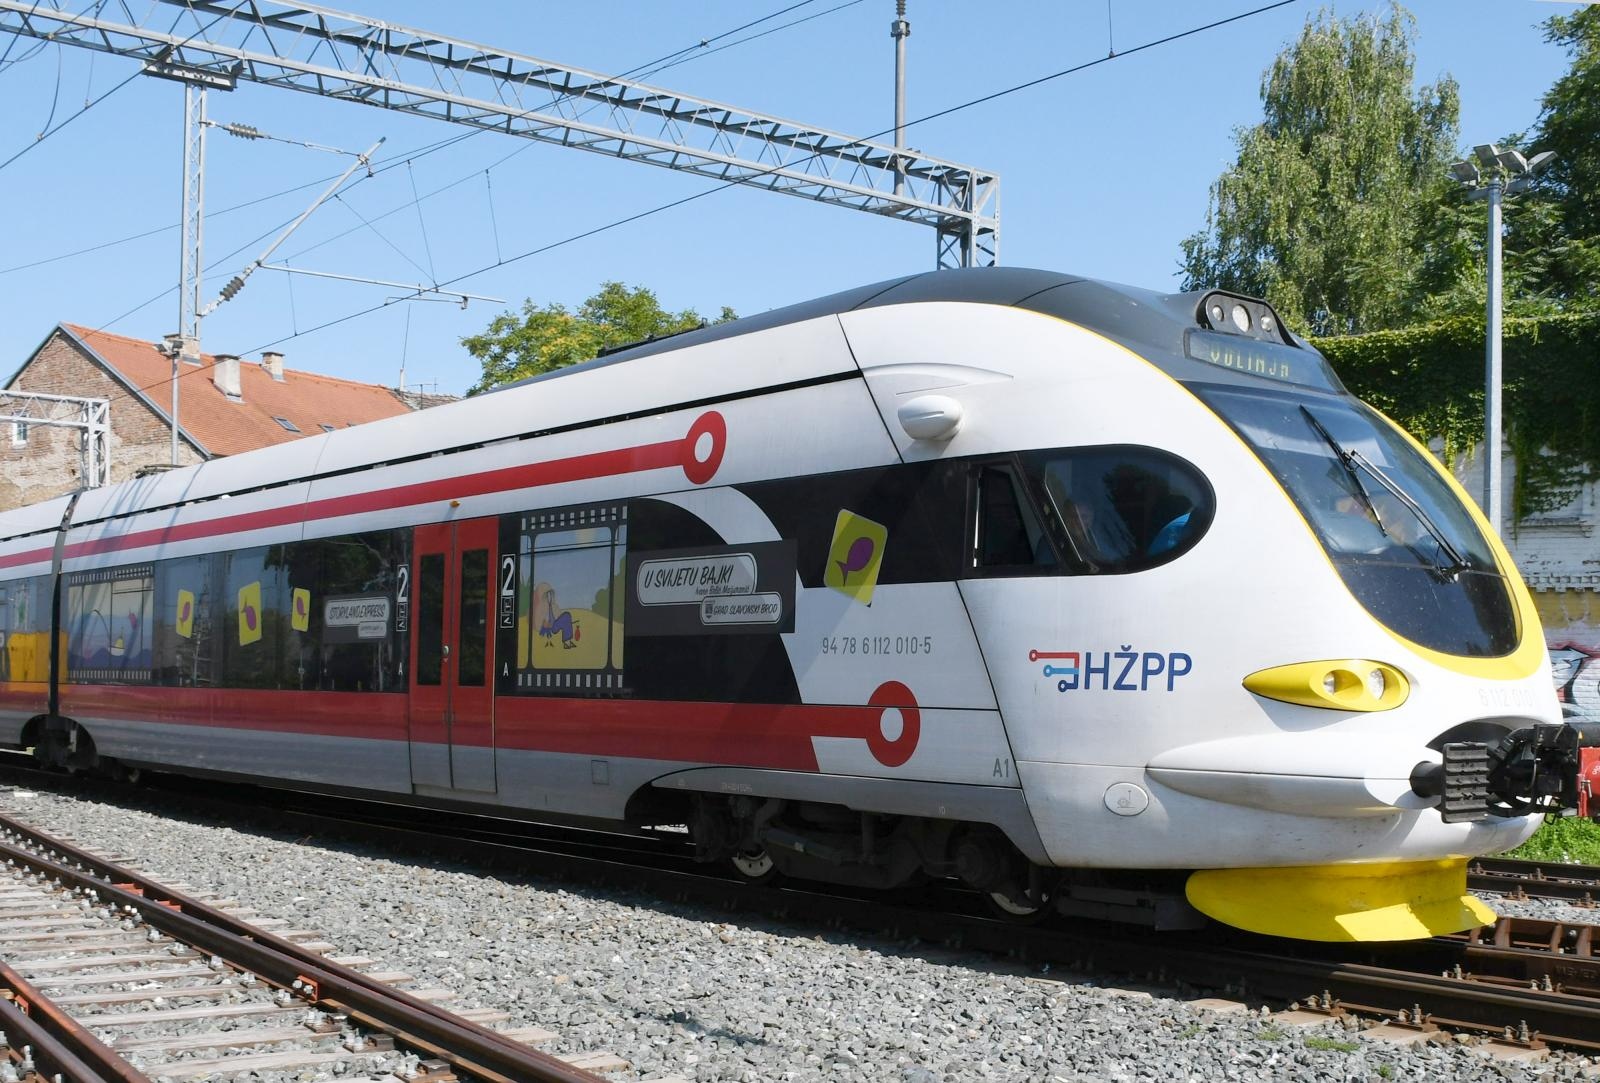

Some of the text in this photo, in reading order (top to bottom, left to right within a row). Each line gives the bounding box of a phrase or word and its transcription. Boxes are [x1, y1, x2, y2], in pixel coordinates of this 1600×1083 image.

[398, 567, 408, 603] 2
[503, 556, 515, 597] 2
[644, 564, 734, 589] U SVIJETU BAJKI
[760, 603, 778, 614] BROD
[822, 636, 838, 655] 94
[842, 636, 857, 655] 78
[895, 635, 932, 655] 010-5
[503, 661, 509, 676] A
[1084, 644, 1193, 692] HŽPP
[992, 757, 1009, 778] A1
